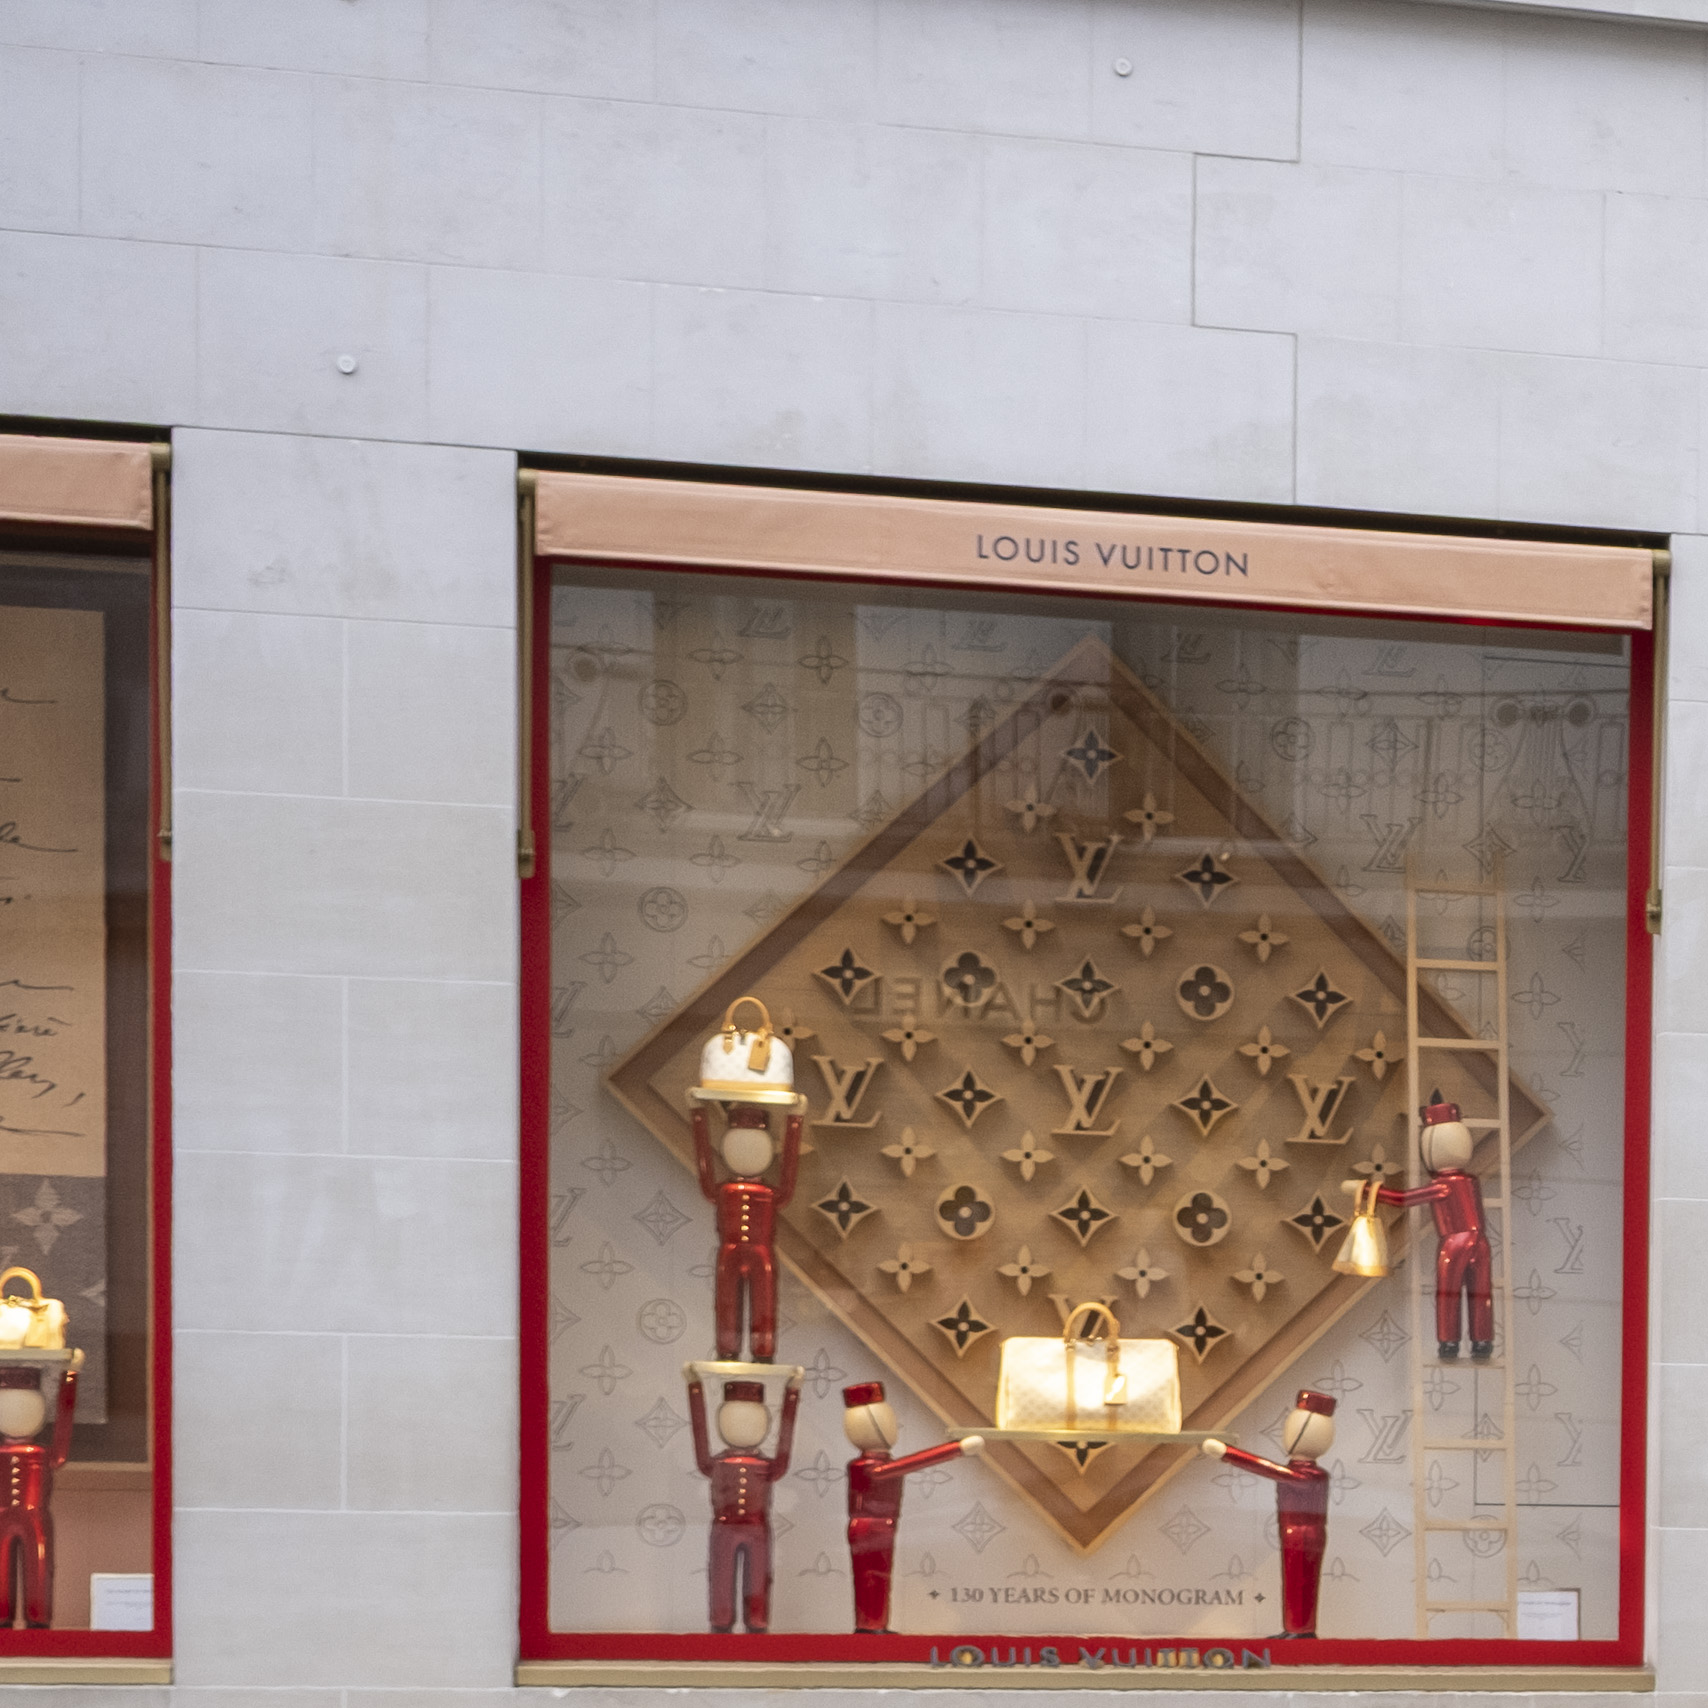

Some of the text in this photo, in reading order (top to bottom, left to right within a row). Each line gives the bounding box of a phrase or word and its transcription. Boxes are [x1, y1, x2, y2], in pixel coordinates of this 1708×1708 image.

[976, 534, 1250, 578] LOUIS VUITTON
[950, 1587, 1246, 1606] 130 YEARS OF MONOGRAM
[929, 1645, 1272, 1670] LOUIS VUITTON
